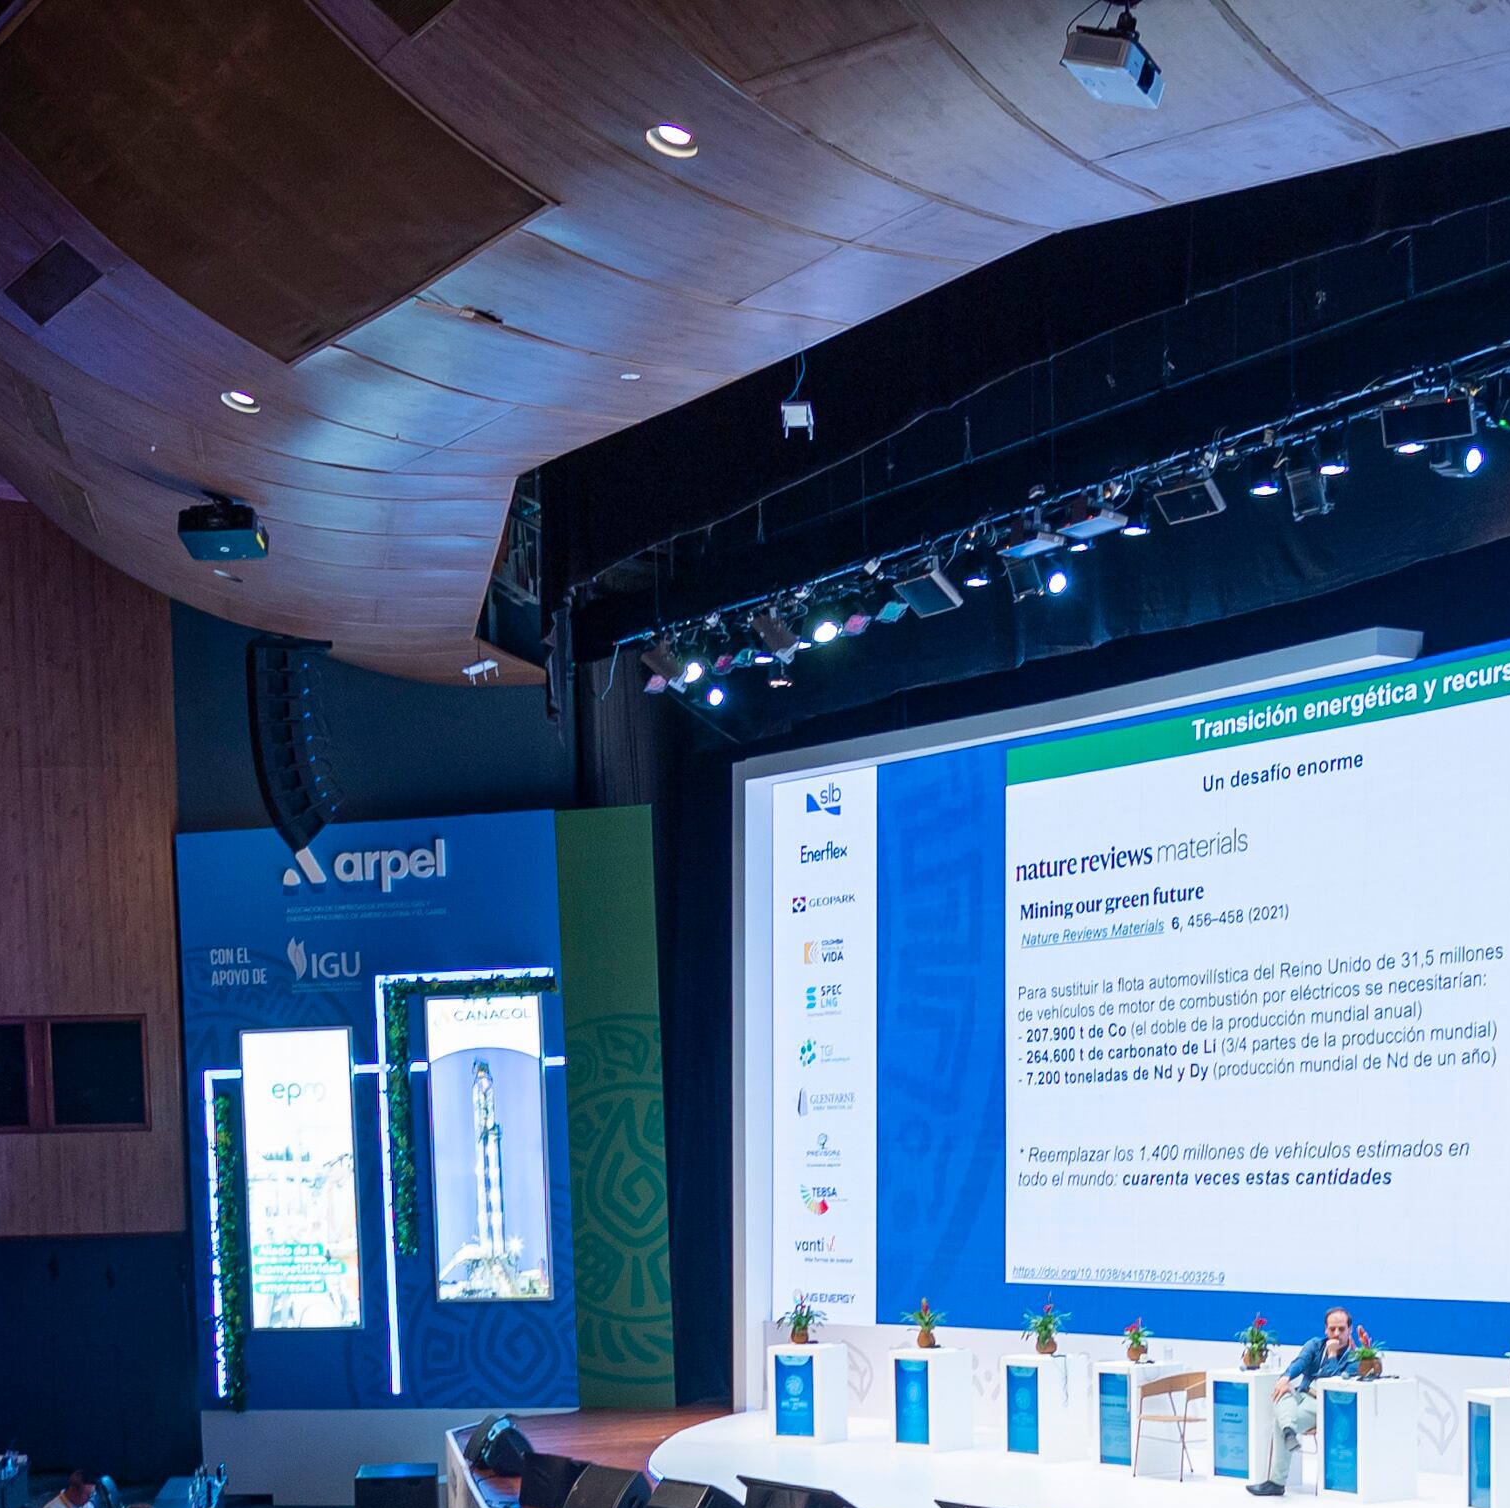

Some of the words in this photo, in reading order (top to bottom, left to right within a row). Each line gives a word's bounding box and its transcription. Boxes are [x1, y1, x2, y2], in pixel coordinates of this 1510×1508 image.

[1192, 704, 1298, 741] Transición
[1303, 680, 1418, 721] energética
[1422, 677, 1438, 704] y
[1202, 775, 1225, 793] Un
[1230, 764, 1291, 789] desafío
[1296, 753, 1364, 777] enorme
[820, 782, 841, 804] slb
[801, 841, 847, 863] Enerflex
[1015, 855, 1077, 882] nature
[1081, 845, 1153, 874] reviews
[1157, 828, 1248, 863] materials
[334, 838, 446, 893] arpel
[809, 893, 855, 907] GEOPARK
[1020, 900, 1074, 921] Mining
[1077, 897, 1102, 915] our
[1105, 890, 1150, 916] green
[1153, 883, 1205, 906] future
[210, 949, 233, 966] CON
[237, 947, 250, 964] EL
[311, 951, 361, 979] IGU
[822, 951, 843, 963] VIDA
[211, 969, 248, 986] APOYO
[252, 968, 267, 984] DE
[1018, 984, 1047, 1001] Para
[1051, 978, 1099, 999] sustituir
[1102, 978, 1113, 995] la
[1117, 975, 1144, 993] flota
[1149, 967, 1249, 991] automovilística
[1253, 964, 1276, 982] del
[1279, 960, 1323, 979] Reino
[1328, 956, 1372, 975] Unido
[1376, 954, 1397, 971] de
[1401, 950, 1435, 970] 31,5
[1439, 943, 1504, 966] millones
[821, 984, 841, 996] SPEC
[821, 998, 837, 1008] LNG
[453, 1007, 532, 1022] CANACOL
[1018, 1170, 1047, 1187] todo
[1052, 1170, 1064, 1187] el
[1068, 1170, 1117, 1187] mundo:
[1122, 1170, 1188, 1187] cuarenta
[1194, 1172, 1240, 1186] veces
[1245, 1170, 1290, 1186] estas
[1295, 1168, 1392, 1186] cantidades
[812, 1187, 837, 1198] TEBSA
[795, 1238, 824, 1252] vanti
